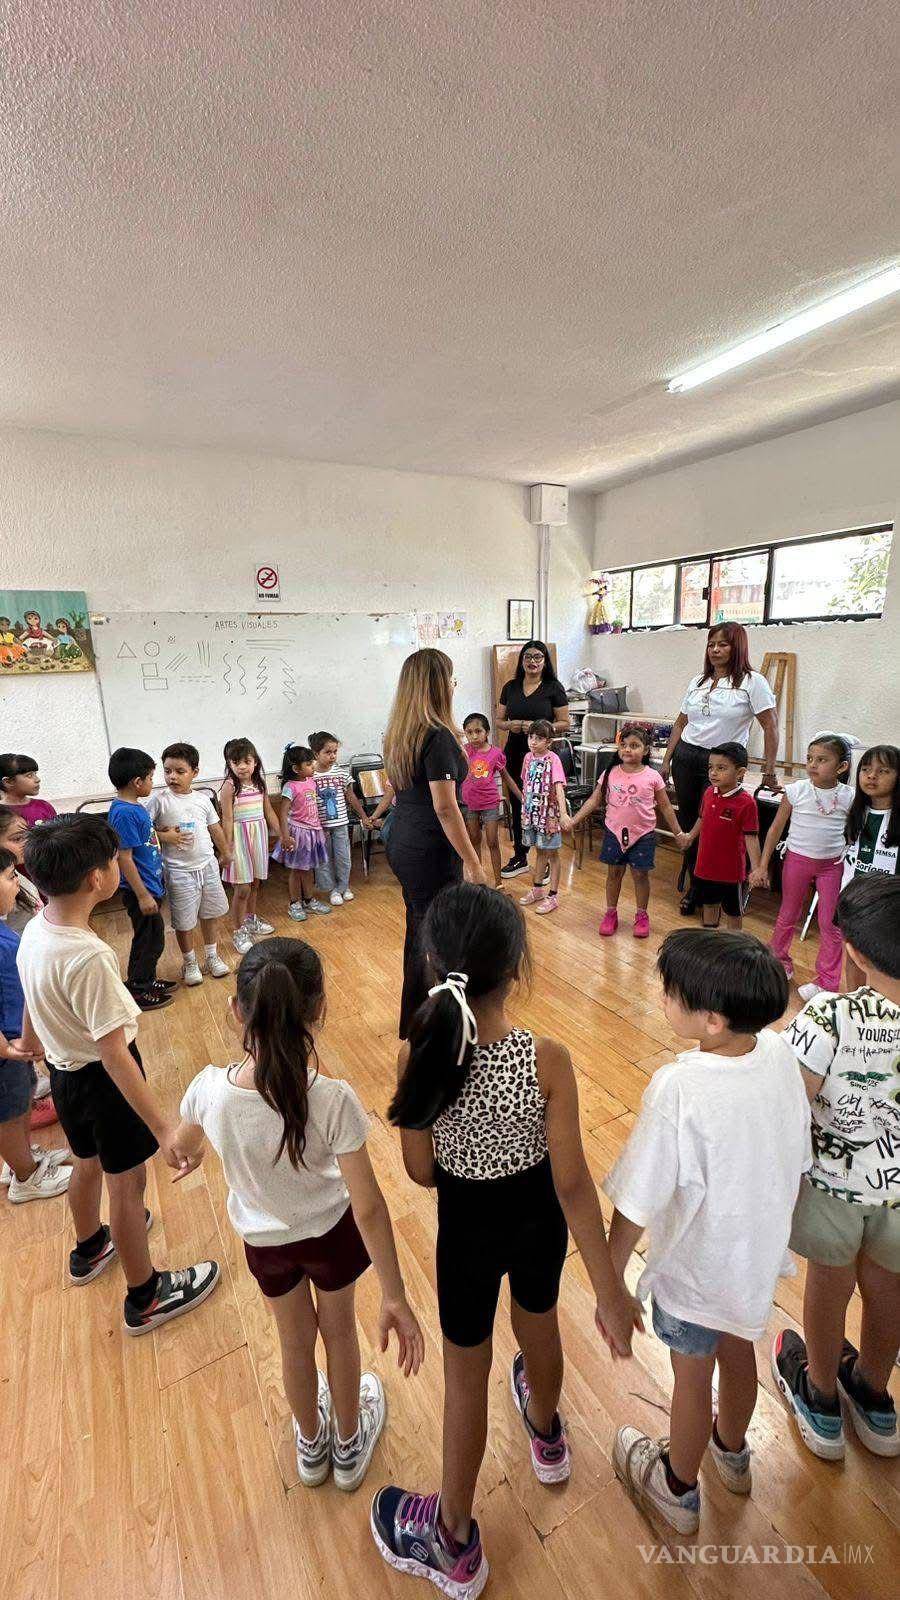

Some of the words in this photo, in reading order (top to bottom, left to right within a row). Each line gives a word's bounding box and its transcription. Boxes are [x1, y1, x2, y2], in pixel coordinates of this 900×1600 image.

[214, 620, 238, 631] ARTES
[241, 620, 279, 630] VISUALES
[848, 997, 900, 1025] ALW
[857, 1026, 900, 1043] YOURS
[837, 1094, 862, 1111] City
